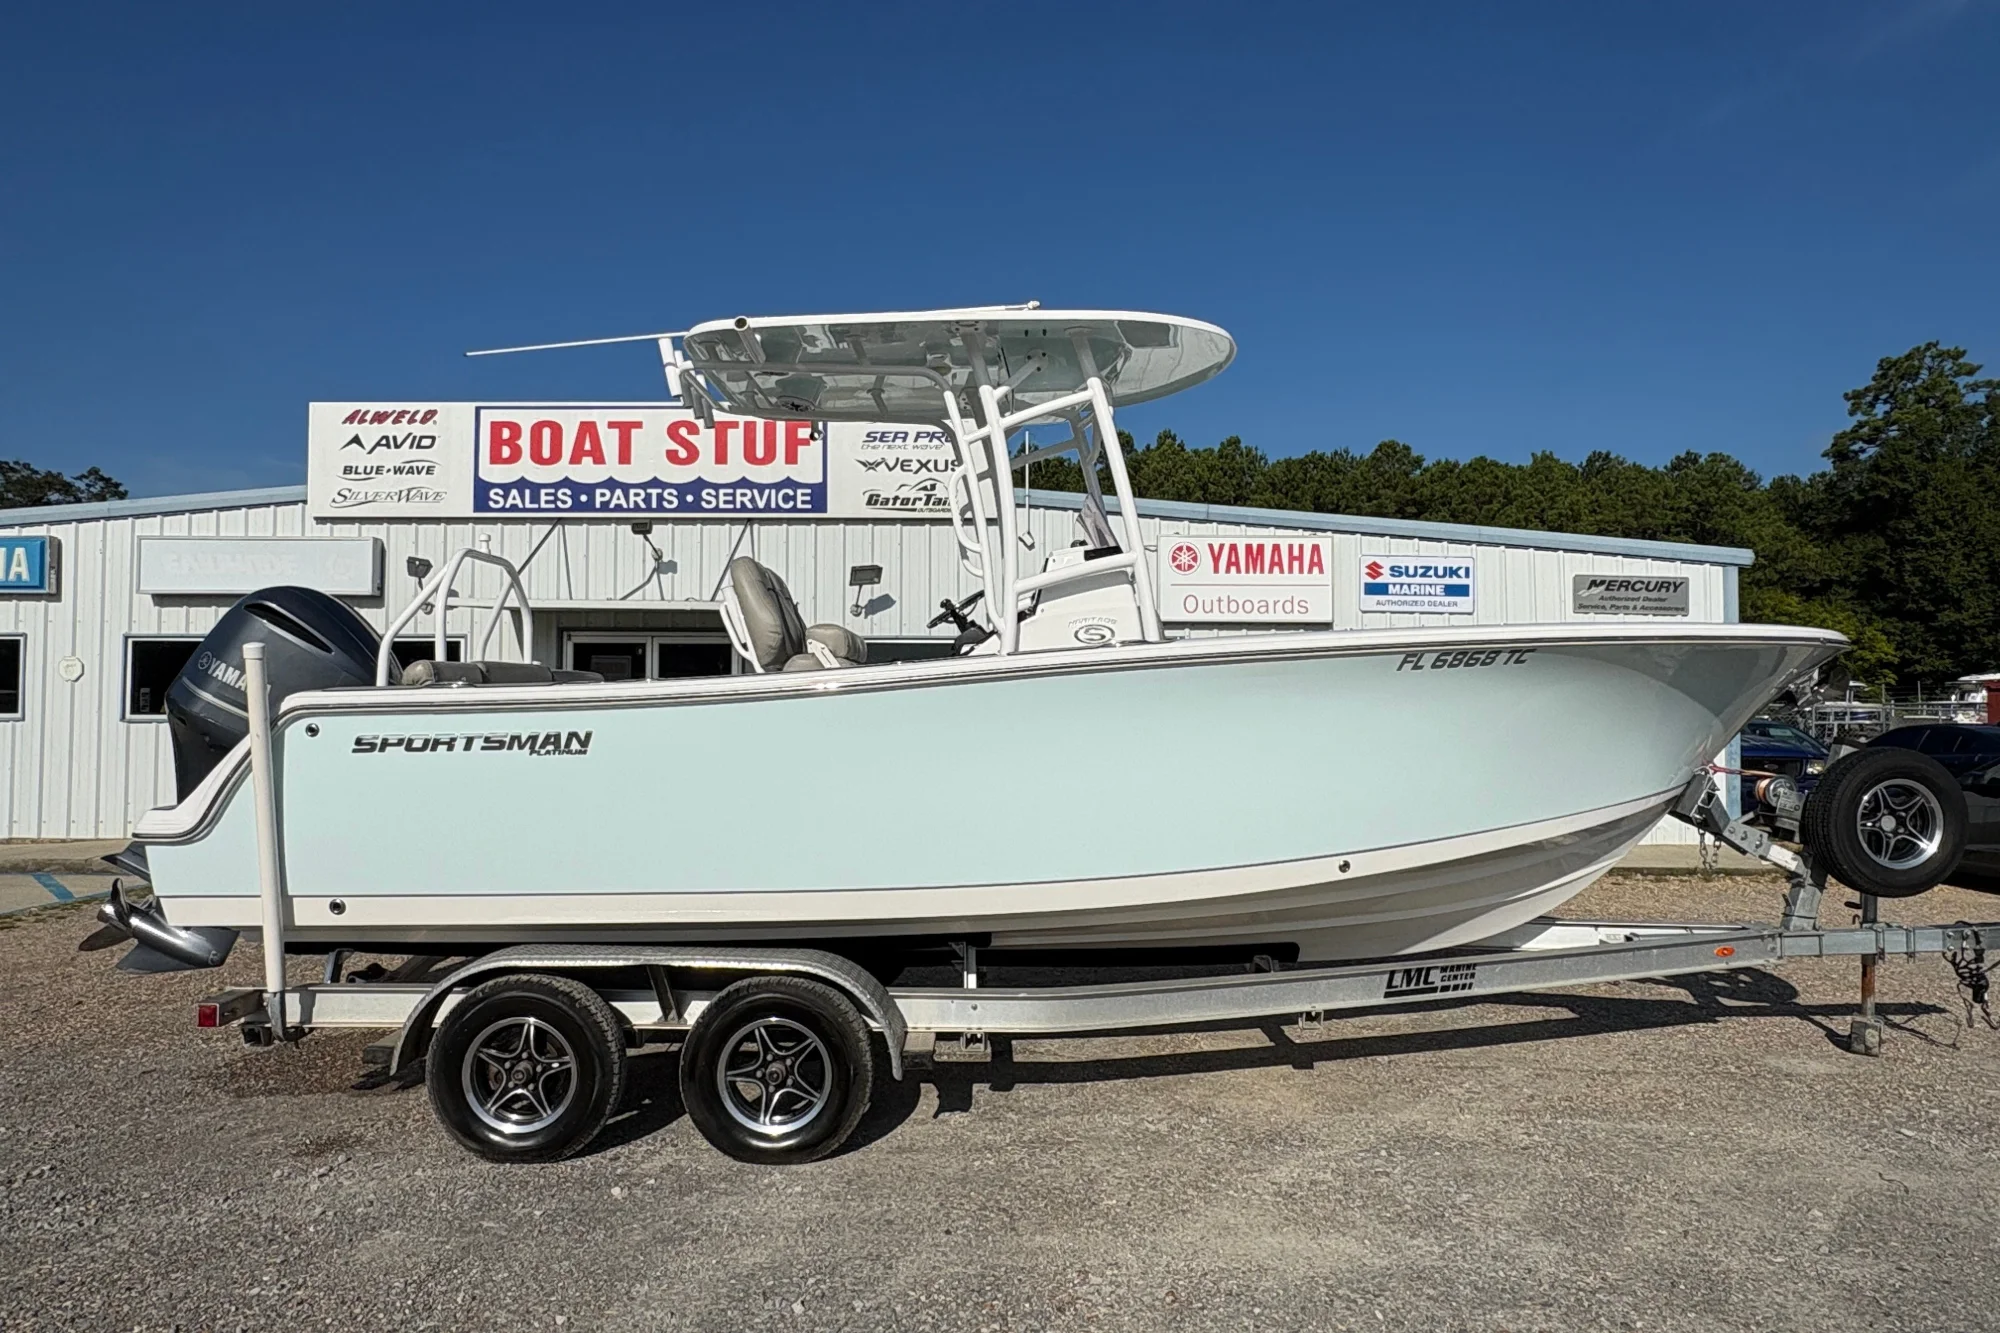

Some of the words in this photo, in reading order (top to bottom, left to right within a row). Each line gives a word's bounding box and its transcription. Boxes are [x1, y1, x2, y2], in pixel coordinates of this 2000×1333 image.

[342, 409, 438, 425] ALWELD
[366, 432, 437, 455] AVID
[489, 420, 643, 466] BOAT
[863, 431, 909, 443] SEA
[488, 488, 571, 509] SALES
[595, 488, 678, 509] PARTS
[701, 488, 812, 509] SERVICE
[1208, 543, 1325, 575] YAMAHA
[1388, 565, 1470, 579] SUZUKI
[1387, 584, 1445, 596] MARINE
[1587, 579, 1685, 593] MERCURY
[1183, 594, 1309, 615] Outboards
[1397, 652, 1425, 671] FL
[1430, 650, 1501, 669] 6868
[1503, 648, 1537, 665] TC
[352, 731, 593, 753] SPORTSMAN
[1386, 966, 1440, 989] LMC
